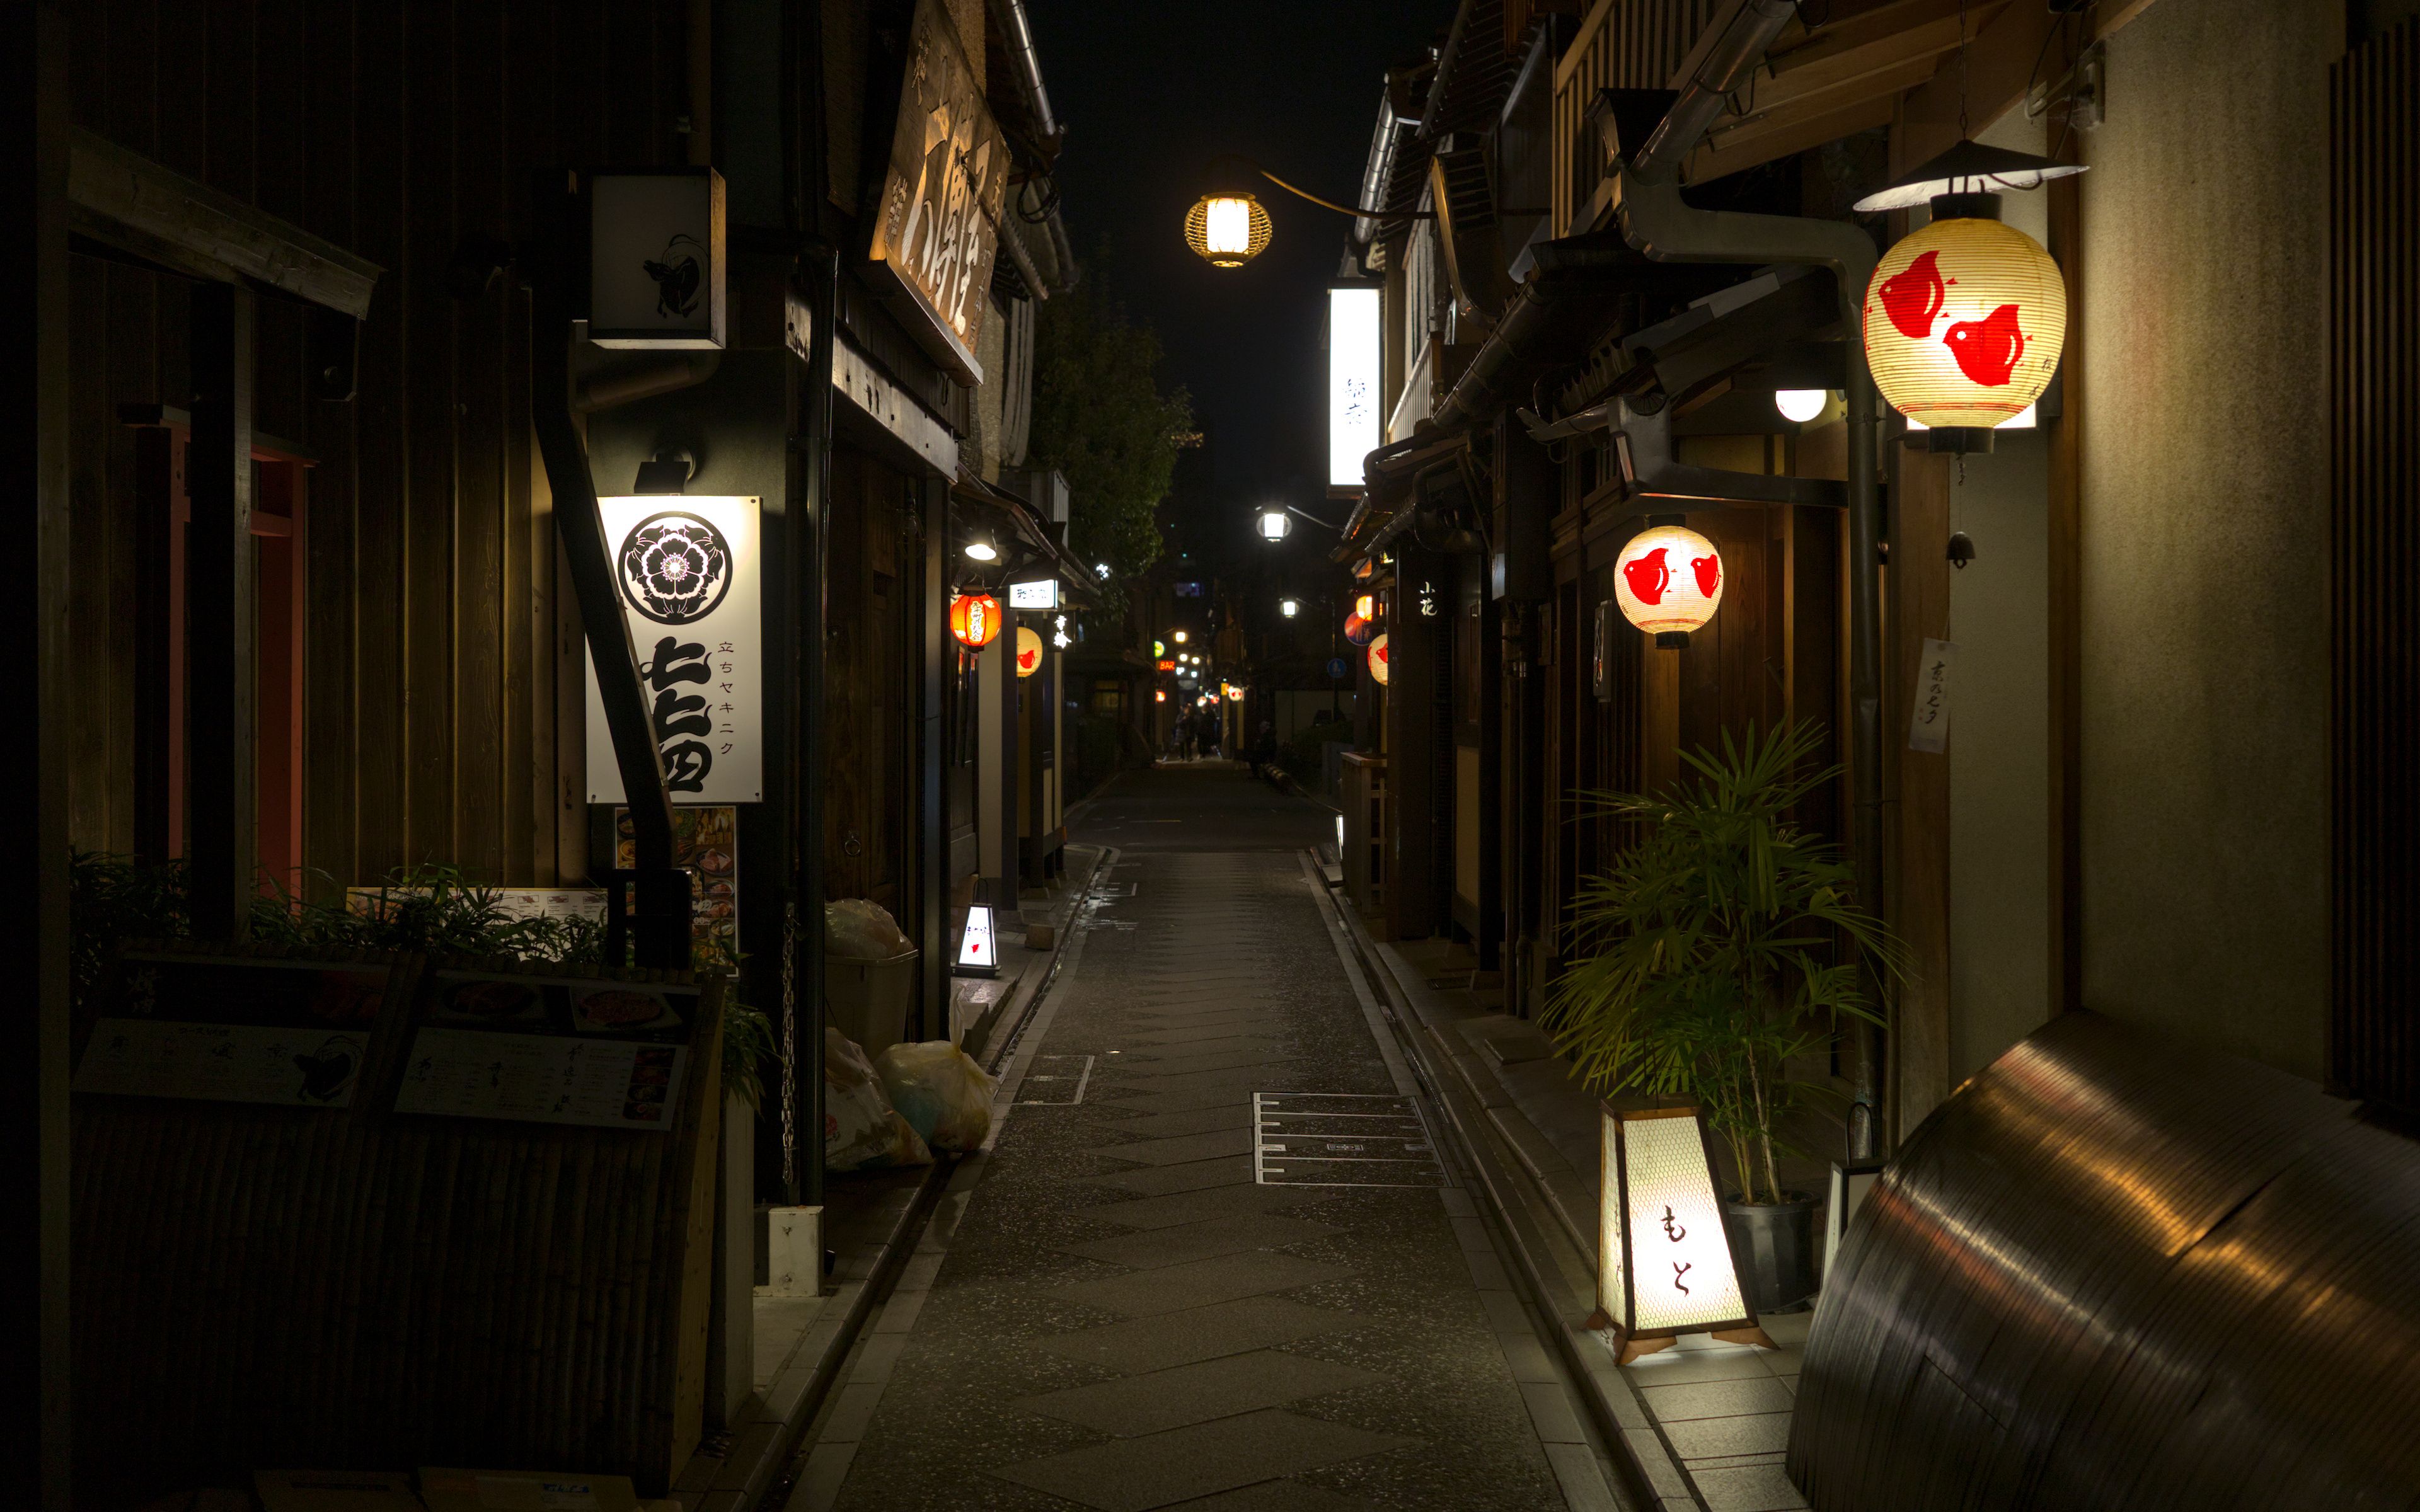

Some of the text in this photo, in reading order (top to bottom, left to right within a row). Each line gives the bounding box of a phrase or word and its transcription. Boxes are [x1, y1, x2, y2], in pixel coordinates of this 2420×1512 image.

[1419, 581, 1438, 616] 小花
[1160, 661, 1175, 670] BAR
[718, 640, 734, 755] 立ちヤキニク
[1660, 1205, 1692, 1297] もと
